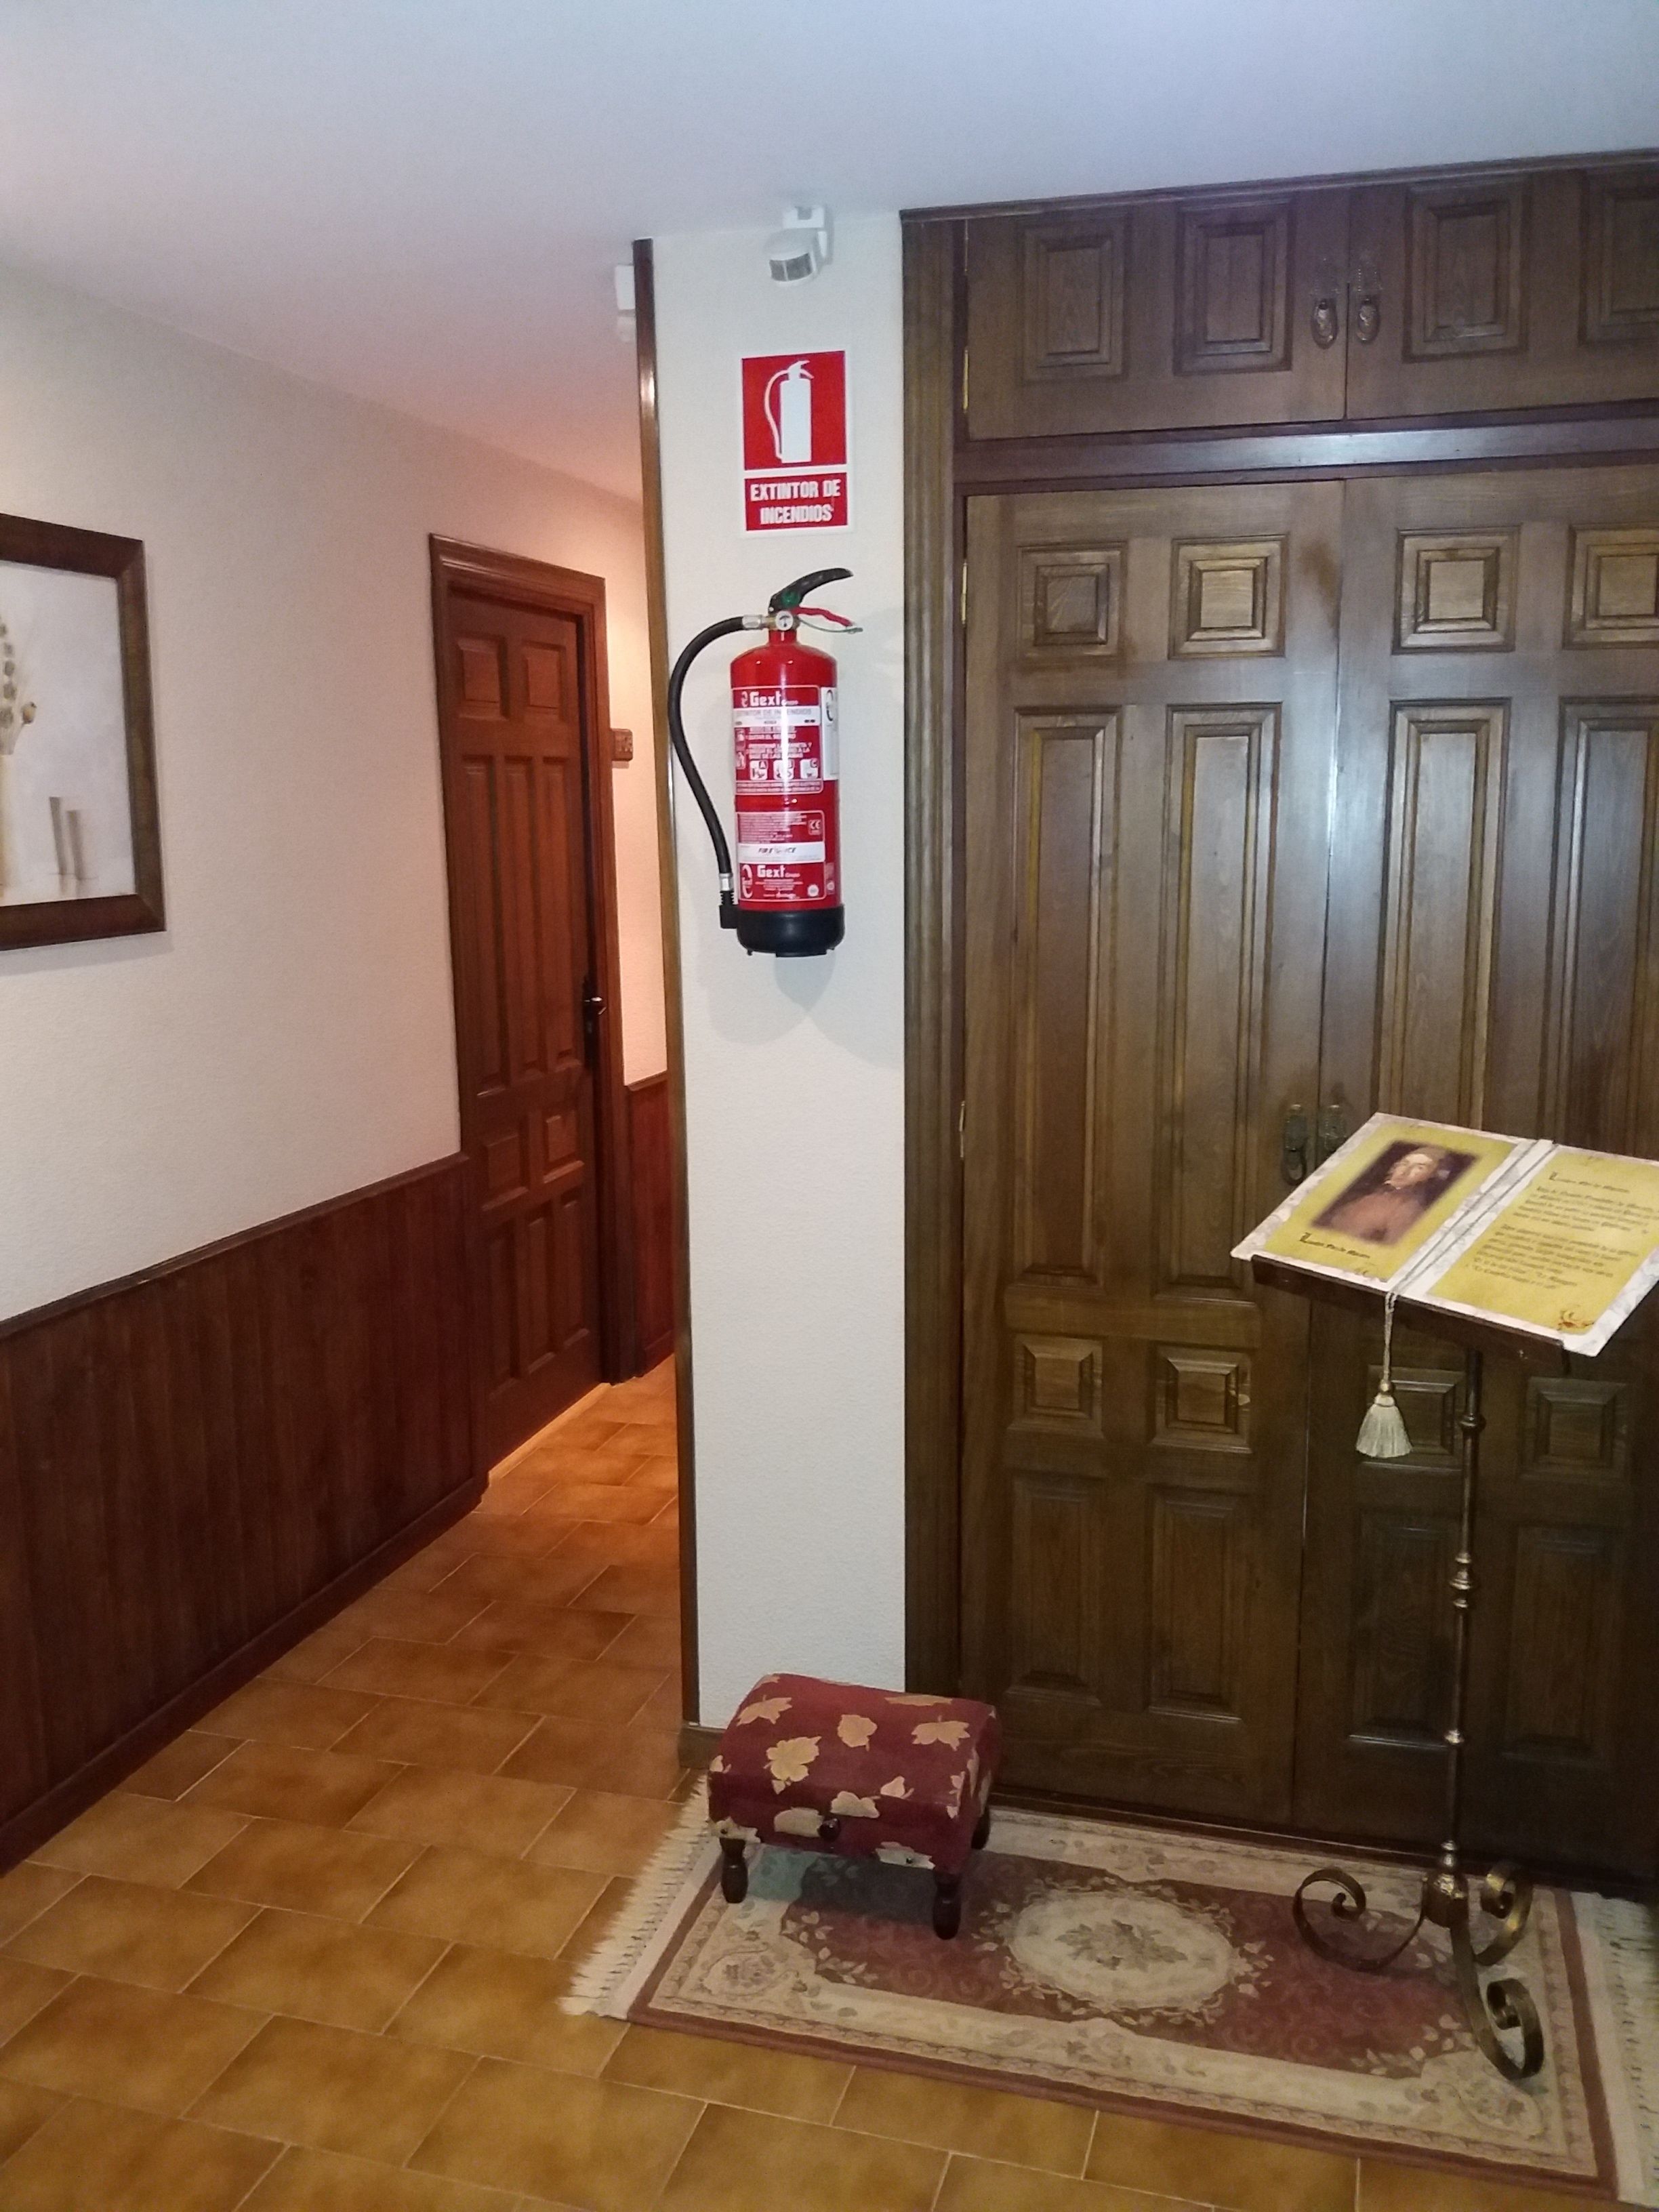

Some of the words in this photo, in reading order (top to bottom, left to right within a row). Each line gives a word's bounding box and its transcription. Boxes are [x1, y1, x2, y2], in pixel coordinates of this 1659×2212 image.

[750, 481, 819, 501] EXTINTOR
[822, 479, 841, 497] DE
[760, 504, 833, 525] INCENDIOS
[750, 691, 781, 707] Gext
[757, 864, 786, 878] Gext
